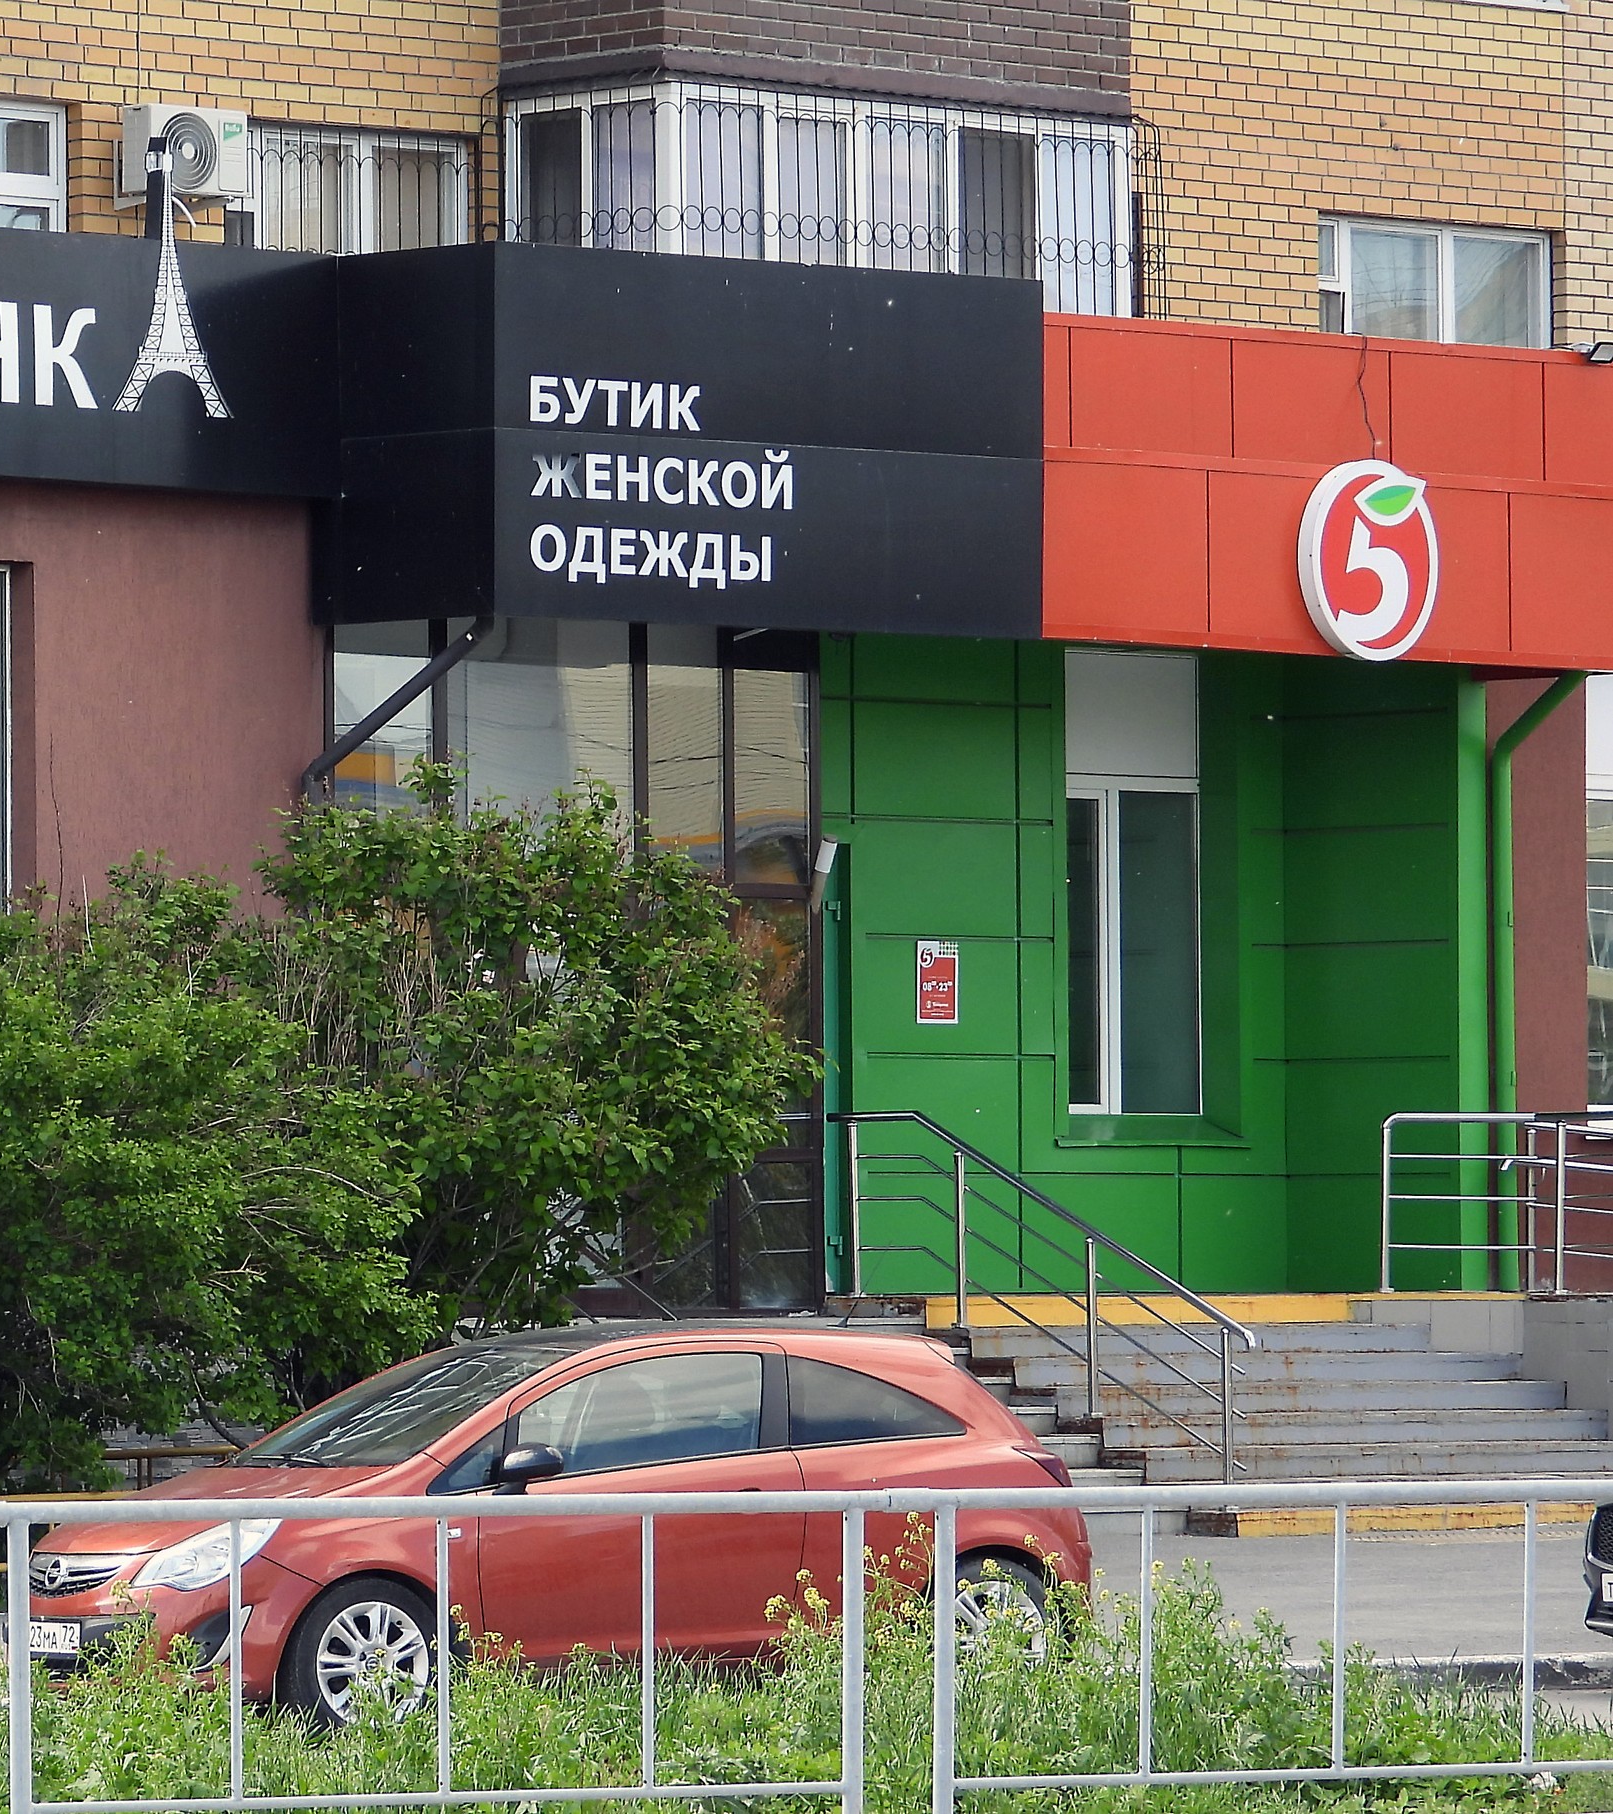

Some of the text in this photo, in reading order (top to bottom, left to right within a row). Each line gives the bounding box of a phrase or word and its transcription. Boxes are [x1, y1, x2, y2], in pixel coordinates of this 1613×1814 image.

[529, 375, 701, 432] БУТИК
[530, 449, 793, 510] ЖЕНСКОЙ
[529, 523, 772, 590] ОДЕЖДЫ
[1335, 476, 1426, 643] 5
[62, 1625, 75, 1643] 72
